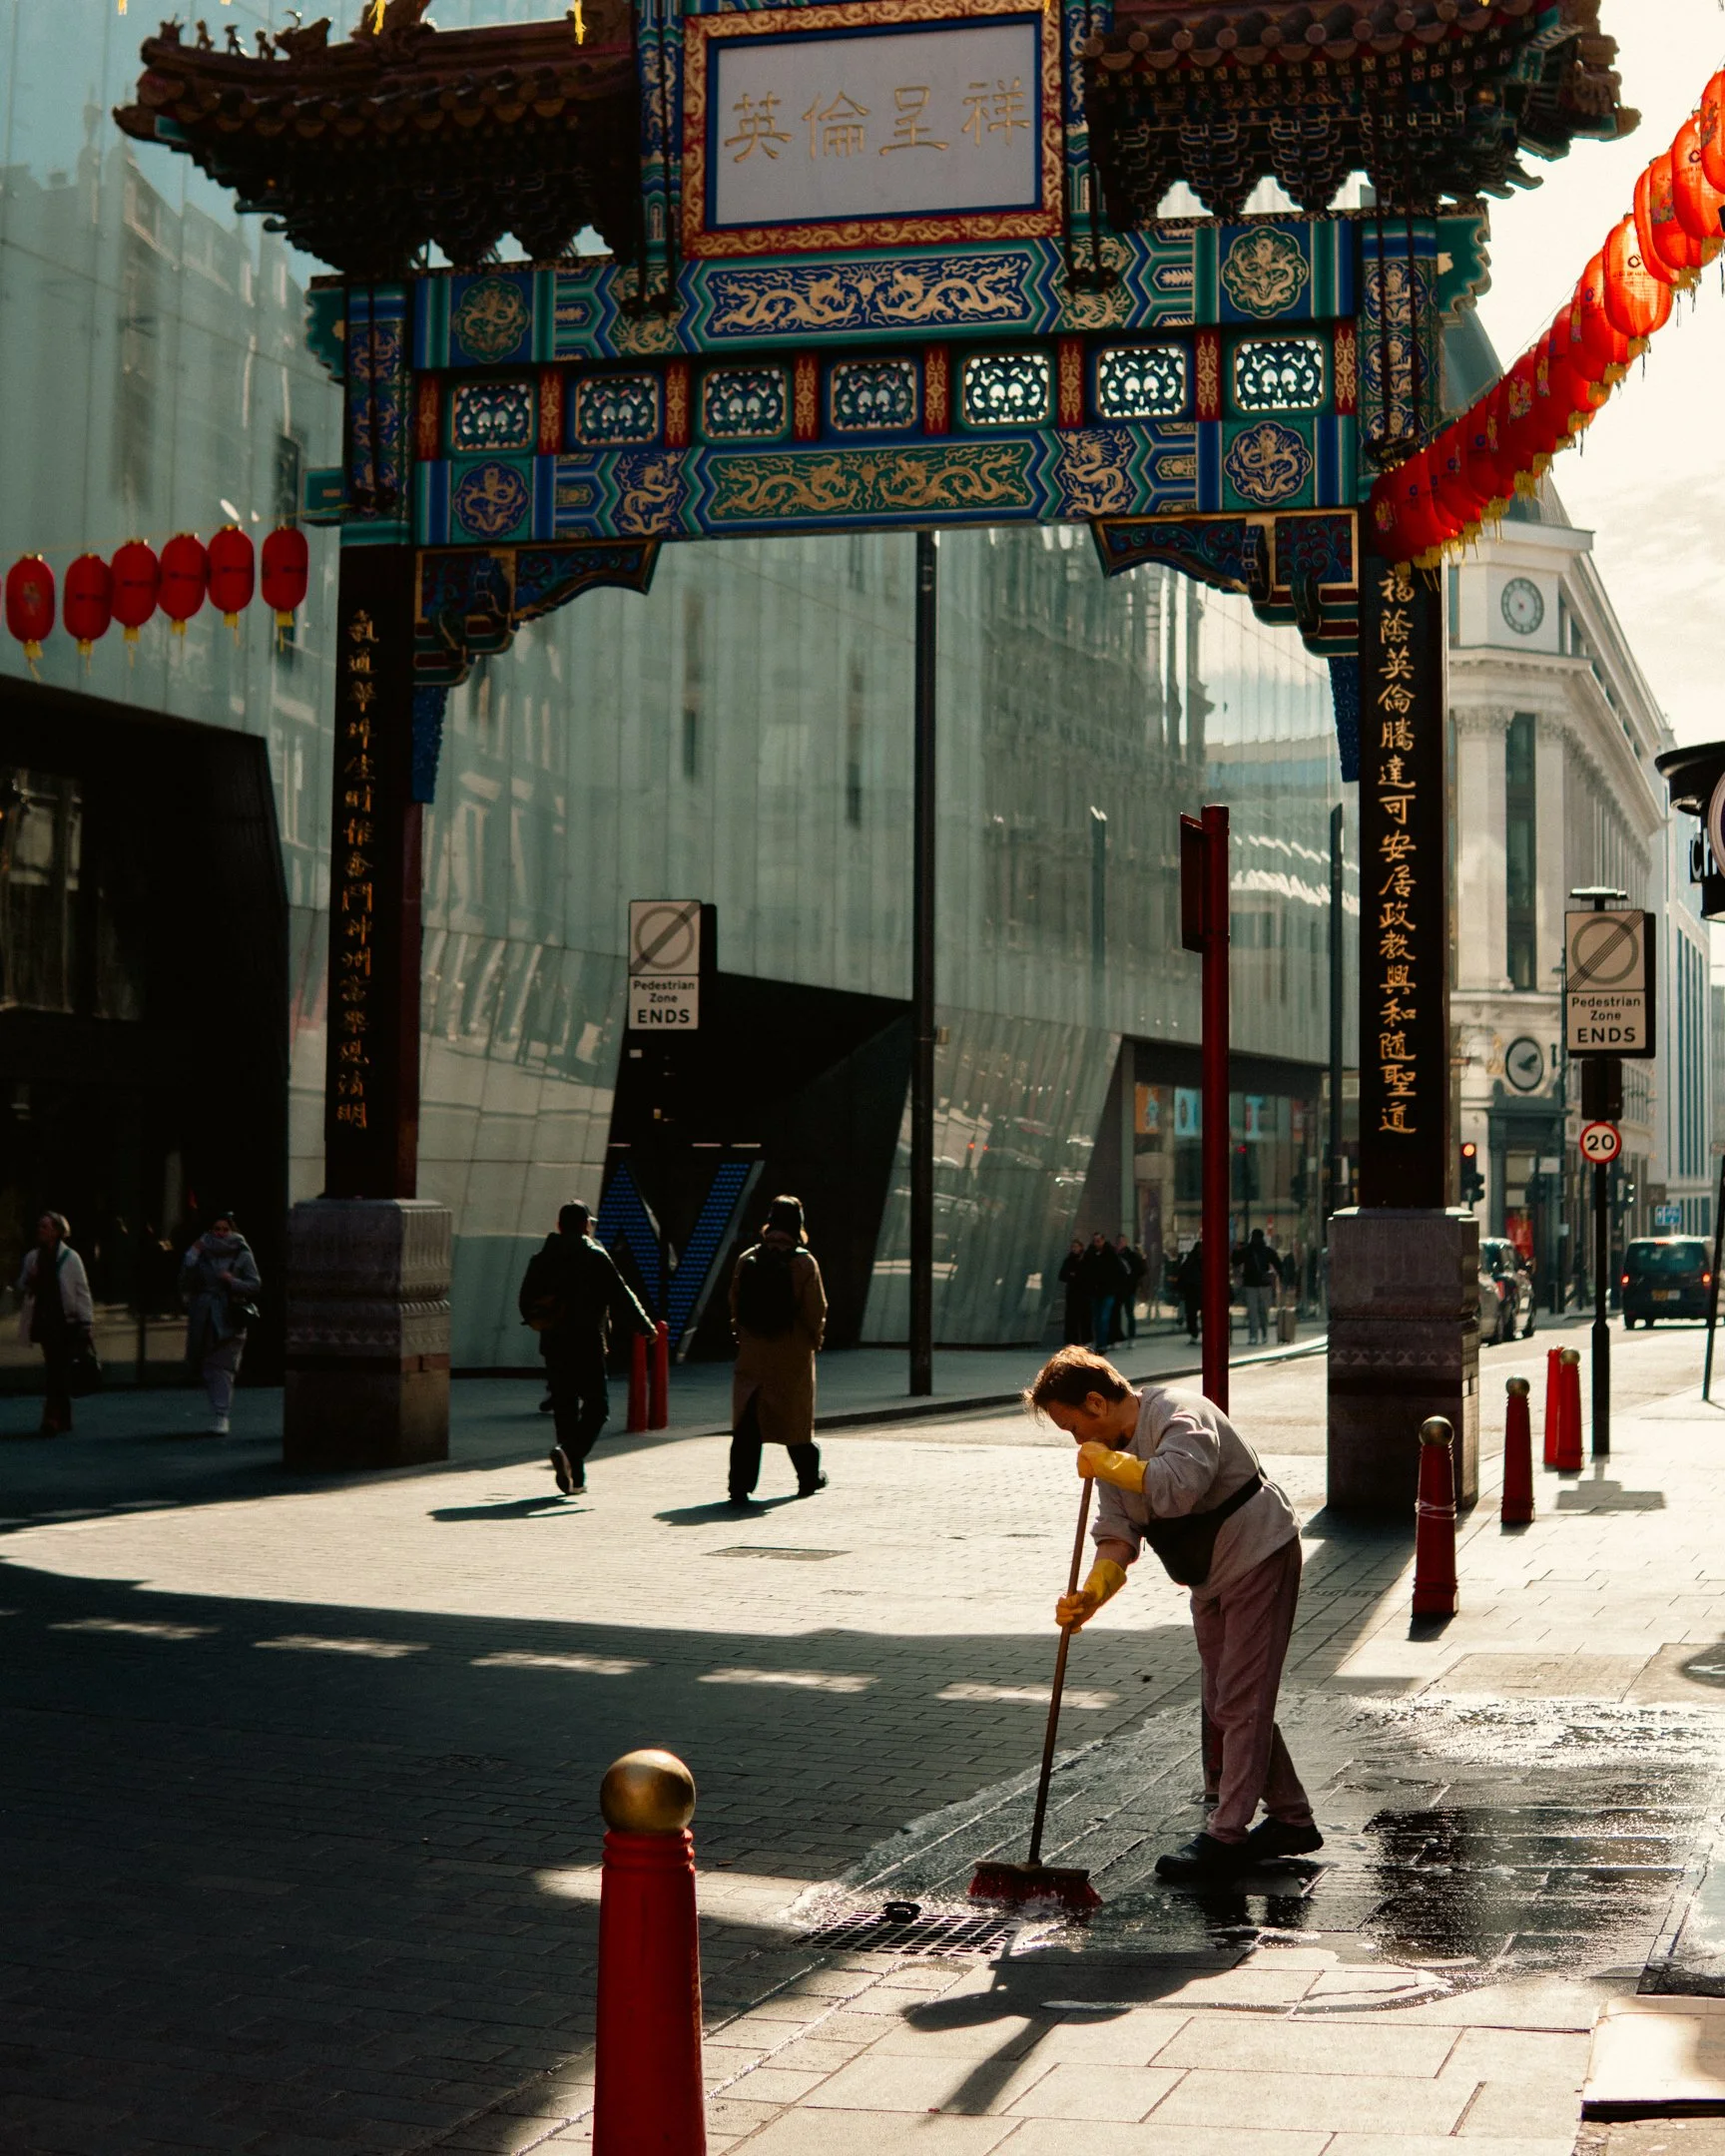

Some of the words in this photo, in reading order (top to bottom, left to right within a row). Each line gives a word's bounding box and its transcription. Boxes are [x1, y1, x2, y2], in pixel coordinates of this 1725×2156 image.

[725, 78, 1030, 163] 英倫呈祥
[633, 980, 695, 991] Pedestrian
[650, 993, 679, 1003] Zone
[1571, 996, 1641, 1008] Pedestrian
[637, 1009, 690, 1024] ENDS
[1589, 1010, 1621, 1022] Zone
[1576, 1027, 1636, 1044] ENDS
[1586, 1134, 1615, 1152] 20
